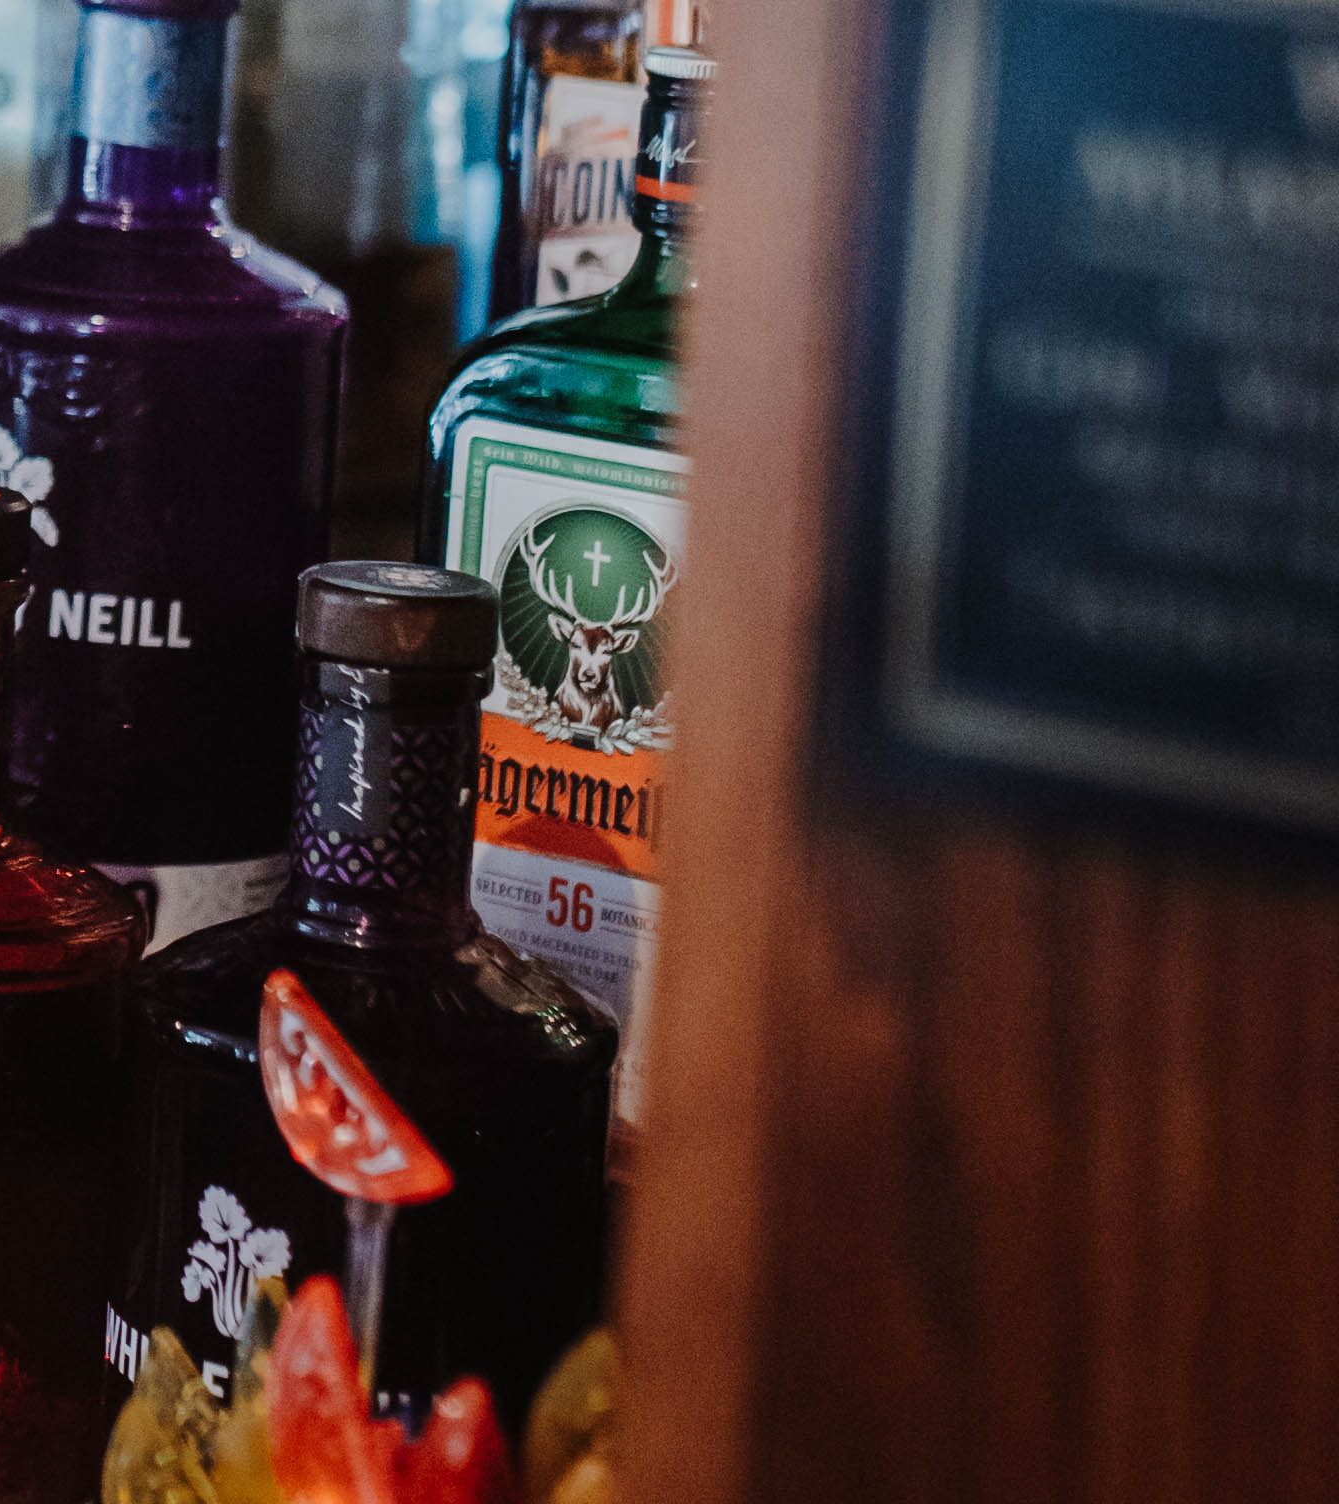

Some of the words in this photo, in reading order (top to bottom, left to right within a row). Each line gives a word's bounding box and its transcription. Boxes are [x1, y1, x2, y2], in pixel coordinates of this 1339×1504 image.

[48, 589, 191, 650] NEILL
[478, 741, 651, 837] ägermei
[475, 878, 542, 905] SELECTED
[546, 876, 594, 933] 56
[600, 908, 659, 932] BOTANIC
